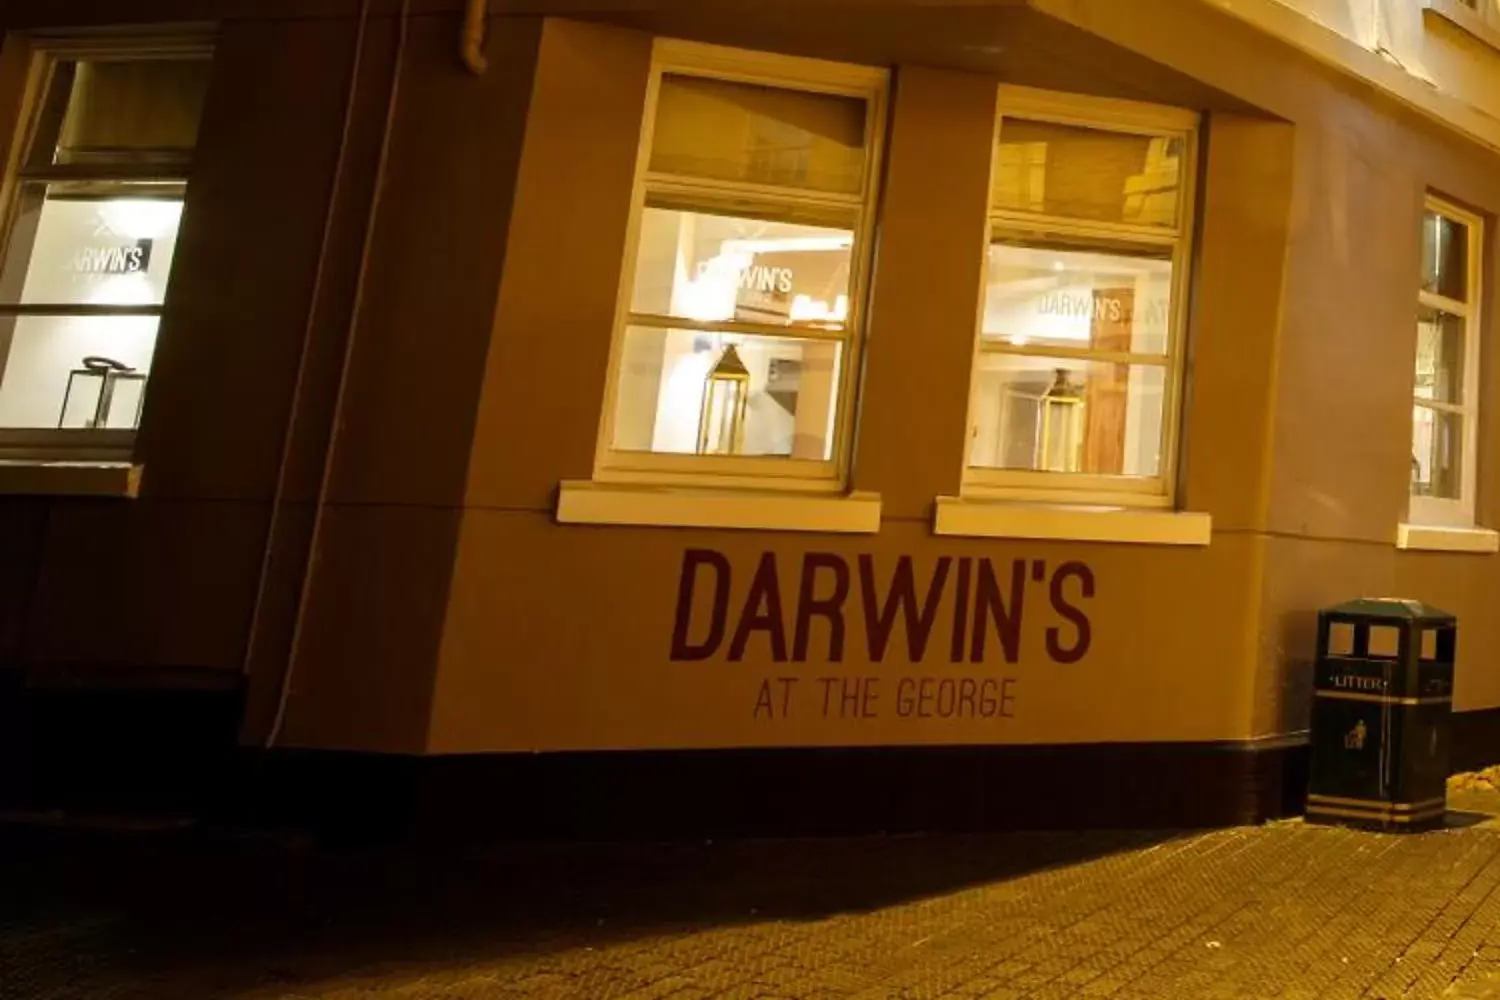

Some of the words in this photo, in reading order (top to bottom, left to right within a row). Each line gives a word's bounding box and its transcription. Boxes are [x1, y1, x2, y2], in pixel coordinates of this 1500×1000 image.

[70, 247, 143, 273] ARWIN'S
[669, 548, 1095, 664] DARWIN'S
[753, 677, 800, 719] AT
[817, 677, 881, 718] THE
[895, 677, 1017, 719] GEORGE
[1334, 675, 1383, 690] LITTER
